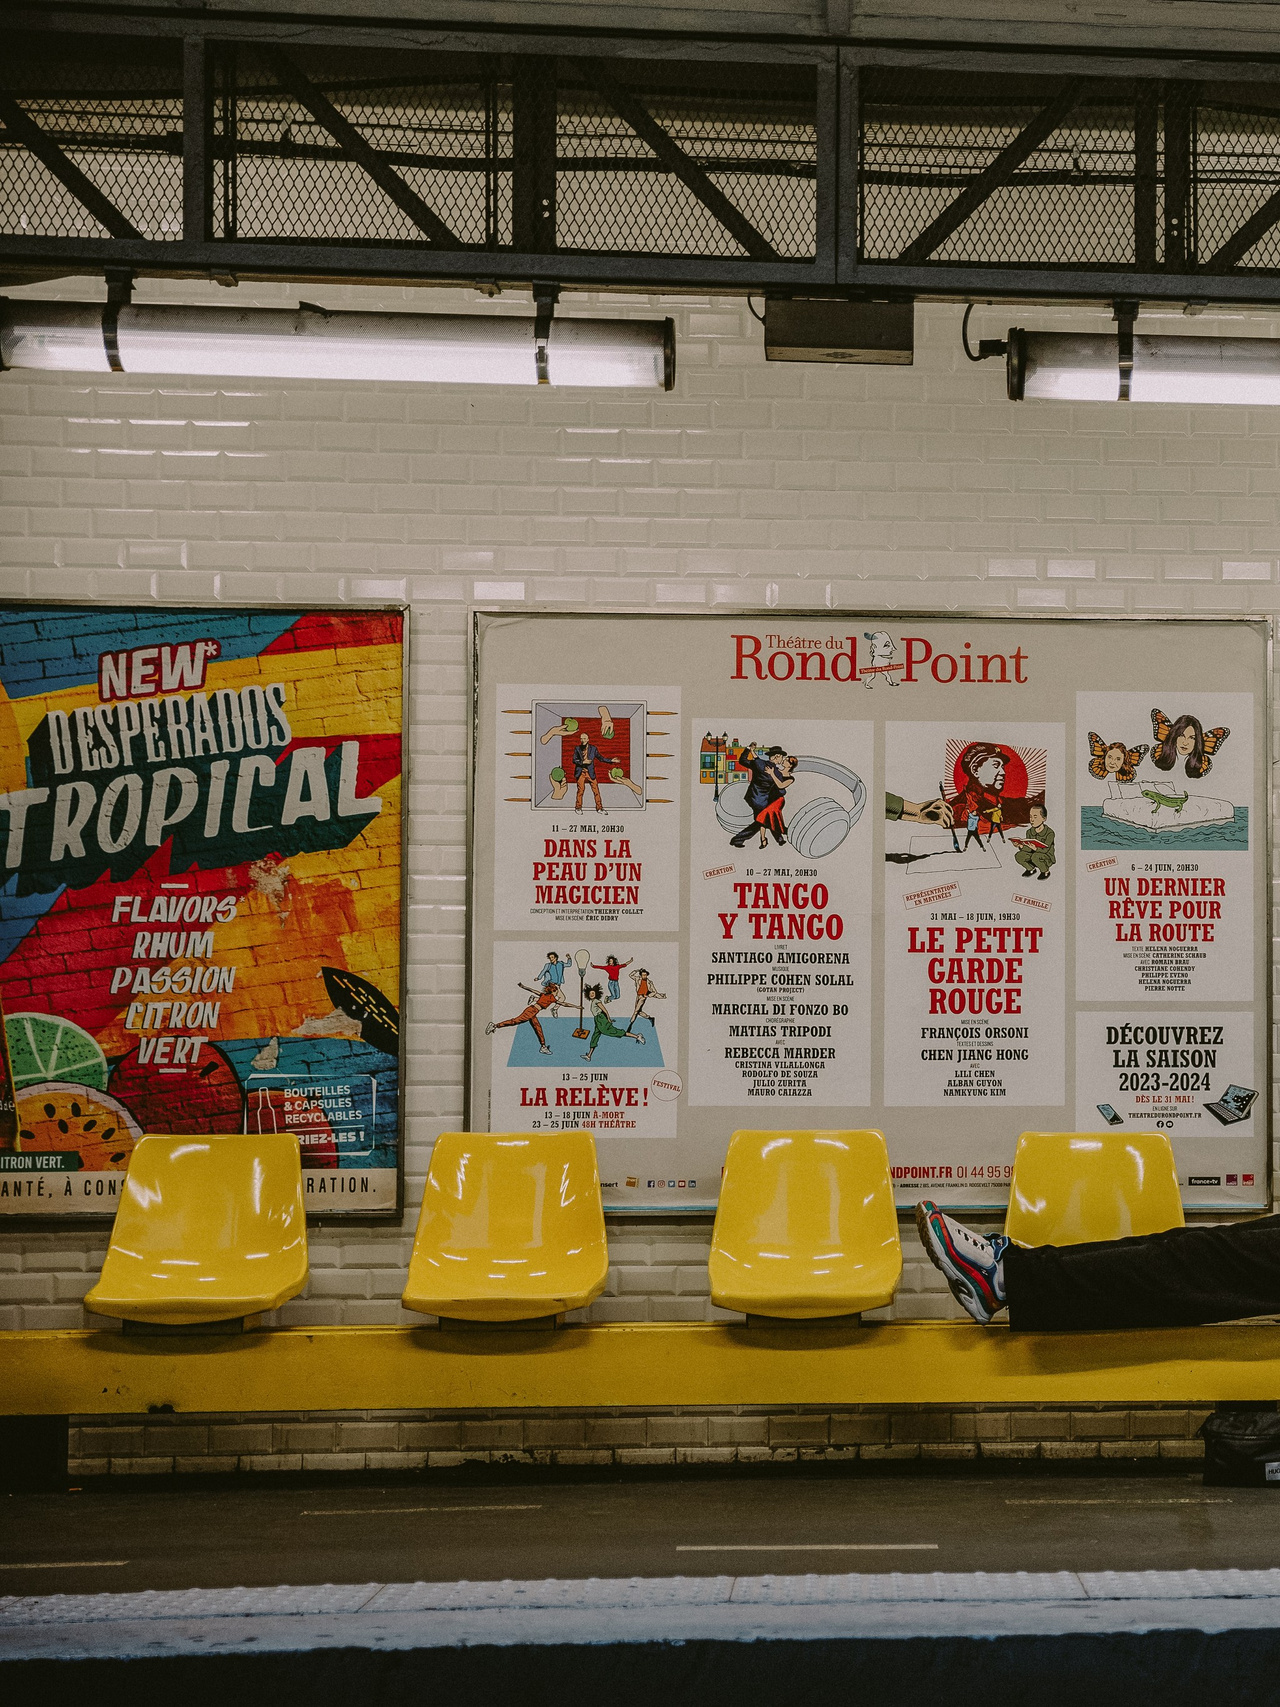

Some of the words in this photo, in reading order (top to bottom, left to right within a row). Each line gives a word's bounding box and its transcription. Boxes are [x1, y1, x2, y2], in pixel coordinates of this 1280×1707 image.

[765, 634, 822, 650] Théâtre
[825, 636, 844, 650] du
[730, 634, 862, 682] Rond
[900, 637, 1029, 684] Point
[48, 683, 292, 774] DESPERADOS
[0, 741, 382, 868] TROPICAL
[552, 825, 559, 833] 11
[569, 825, 578, 833] 27
[580, 824, 599, 834] MAI,
[601, 825, 625, 833] 20H30
[543, 839, 597, 858] DANS
[604, 839, 632, 858] LA
[532, 862, 588, 881] PEAU
[594, 862, 642, 882] D'UN
[746, 868, 754, 876] 10
[763, 868, 772, 876] 27
[774, 868, 793, 878] MAI,
[795, 869, 818, 877] 20H30
[1131, 864, 1136, 872] 6
[1144, 864, 1153, 872] 24
[1154, 864, 1175, 873] JUIN,
[1176, 864, 1199, 872] 20H30
[1104, 877, 1130, 896] UN
[1136, 877, 1226, 897] DERNIER
[535, 885, 639, 905] MAGICIEN
[733, 882, 829, 910] TANGO
[1108, 897, 1163, 919] RÊVE
[1169, 900, 1222, 920] POUR
[976, 913, 996, 922] JUIN,
[998, 913, 1021, 921] 19H30
[717, 913, 739, 940] Y
[748, 913, 844, 941] TANGO
[1115, 923, 1143, 942] LA
[1149, 924, 1215, 942] ROUTE
[132, 931, 215, 959] RHUM
[907, 927, 945, 953] LE
[955, 927, 1043, 953] PETIT
[711, 952, 773, 964] SANTIAGO
[776, 952, 850, 965] AMIGORENA
[927, 957, 1023, 984] GARDE
[110, 966, 236, 994] PASSION
[707, 973, 767, 986] PHILIPPE
[771, 974, 811, 986] COHEN
[815, 974, 854, 986] SOLAL
[756, 986, 778, 994] (GOTAN
[929, 988, 1022, 1015] ROUGE
[125, 1001, 221, 1030] CITRON
[711, 1003, 769, 1016] MARCIAL
[772, 1004, 786, 1015] DI
[789, 1004, 829, 1016] FONZO
[832, 1005, 849, 1016] BO
[729, 1025, 777, 1037] MATIAS
[780, 1025, 832, 1037] TRIPODI
[921, 1027, 981, 1041] FRANÇOIS
[985, 1027, 1029, 1039] ORSONI
[1106, 1022, 1224, 1045] DÉCOUVREZ
[137, 1036, 209, 1064] VERT
[724, 1047, 780, 1059] REBECCA
[783, 1047, 836, 1059] MARDER
[921, 1049, 953, 1061] CHEN
[956, 1049, 993, 1063] JIANG
[996, 1049, 1029, 1061] HONG
[735, 1061, 772, 1069] CRISTINA
[774, 1061, 825, 1069] VILALLONGA
[1112, 1049, 1140, 1068] LA
[1146, 1049, 1217, 1068] SAISON
[562, 1073, 571, 1081] 13
[579, 1073, 589, 1081] 25
[590, 1073, 608, 1083] JUIN
[742, 1070, 779, 1078] RODOLFO
[780, 1070, 792, 1078] DE
[793, 1070, 819, 1078] SOUZA
[954, 1070, 972, 1078] LILI
[974, 1070, 995, 1078] CHEN
[652, 1079, 681, 1093] FESTIVAL
[753, 1079, 775, 1089] JULIO
[947, 1079, 974, 1087] ALBAN
[976, 1079, 1003, 1087] GUYON
[1119, 1072, 1211, 1092] 2023-2024
[284, 1085, 351, 1098] BOUTEILLES
[520, 1087, 548, 1107] LA
[747, 1088, 776, 1097] MAURO
[778, 1088, 813, 1097] CAIAZZA
[943, 1088, 988, 1097] NAMKYUNG
[990, 1089, 1006, 1097] KIM
[284, 1102, 293, 1112] &
[294, 1098, 352, 1110] CAPSULES
[1135, 1094, 1150, 1104] DÈS
[1152, 1095, 1163, 1104] LE
[1164, 1095, 1172, 1104] 31
[285, 1110, 363, 1124] RECYCLABLES
[544, 1111, 552, 1119] 13
[562, 1111, 571, 1119] 18
[572, 1111, 591, 1121] JUIN
[532, 1120, 541, 1128] 23
[550, 1120, 560, 1128] 25
[561, 1120, 580, 1130] JUIN
[581, 1120, 596, 1128] 48H
[598, 1119, 636, 1128] THÉÂTRE
[0, 1156, 32, 1169] ITRON
[35, 1156, 65, 1169] VERT.
[956, 1166, 967, 1178] 01
[970, 1166, 984, 1178] 44
[987, 1166, 1001, 1178] 95
[1, 1176, 52, 1199] ANTÉ,
[64, 1176, 72, 1196] À
[306, 1176, 377, 1193] RATION.
